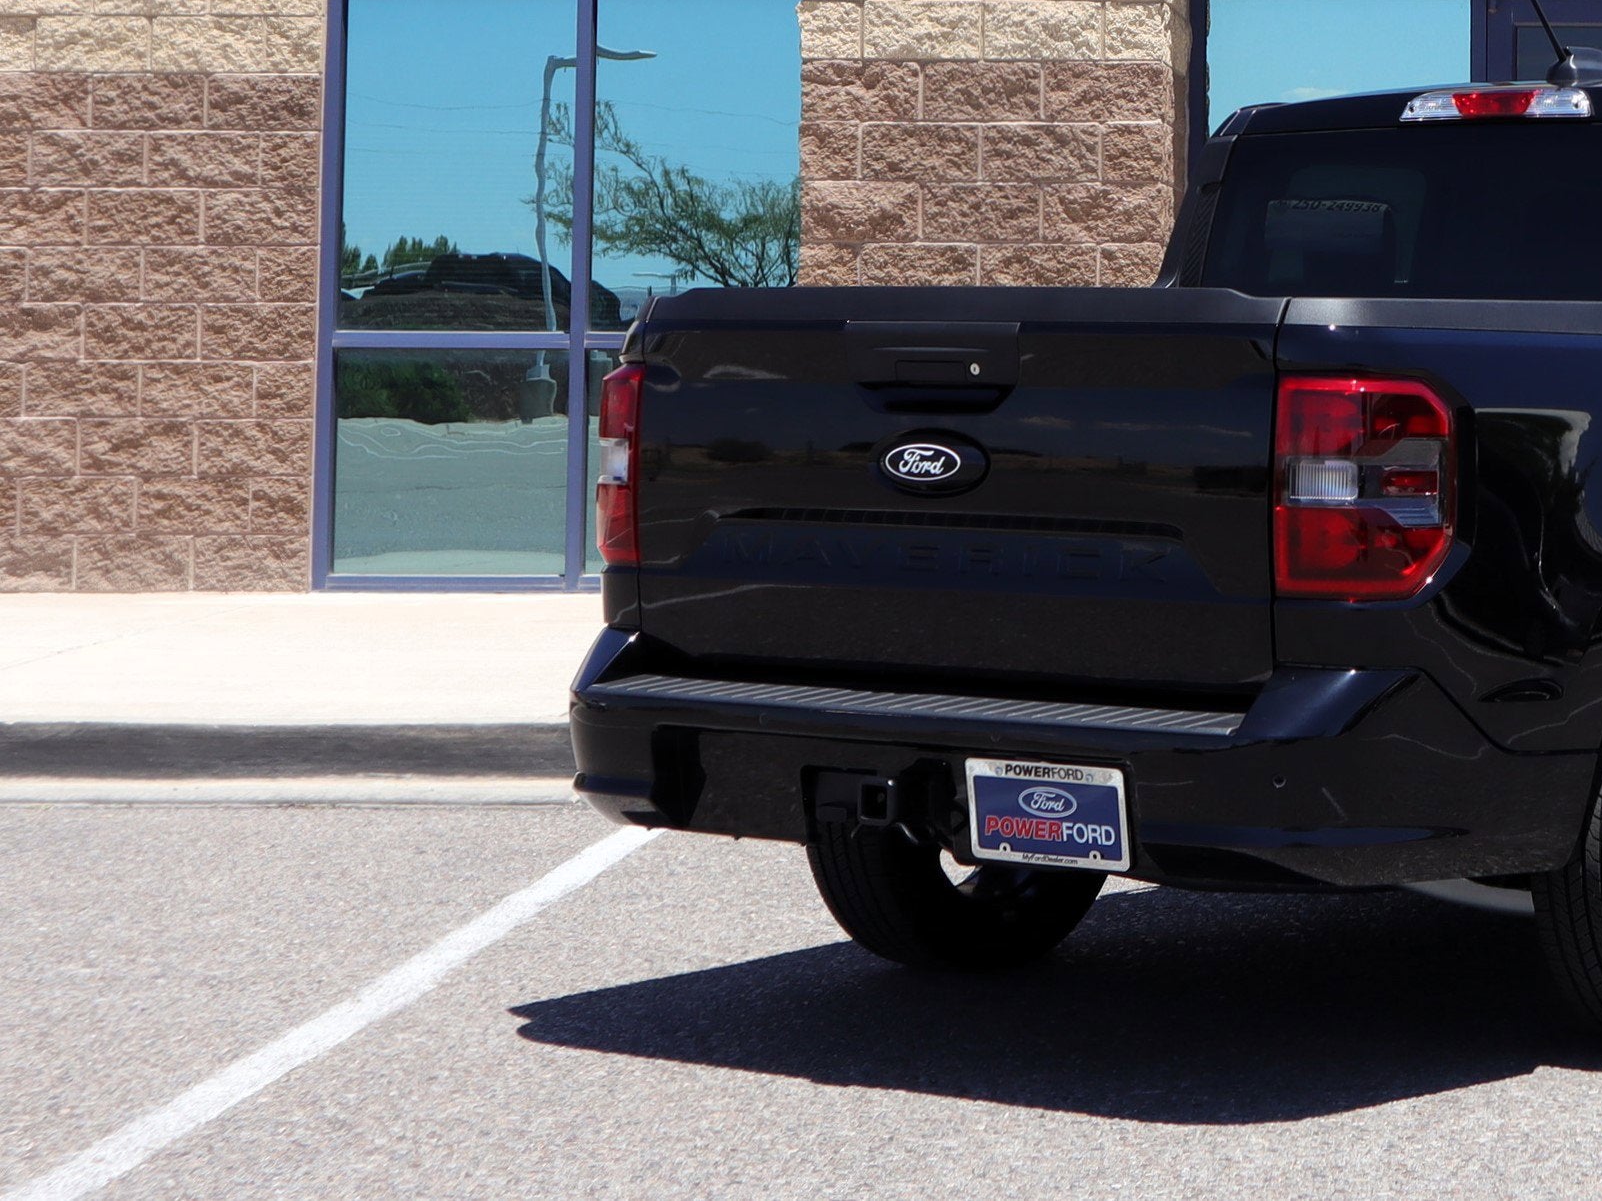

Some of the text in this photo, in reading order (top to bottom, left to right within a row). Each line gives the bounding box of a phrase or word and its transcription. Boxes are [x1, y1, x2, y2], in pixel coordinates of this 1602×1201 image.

[898, 448, 946, 475] Ford
[719, 531, 1169, 584] MAVERICK
[1030, 792, 1065, 812] Ford
